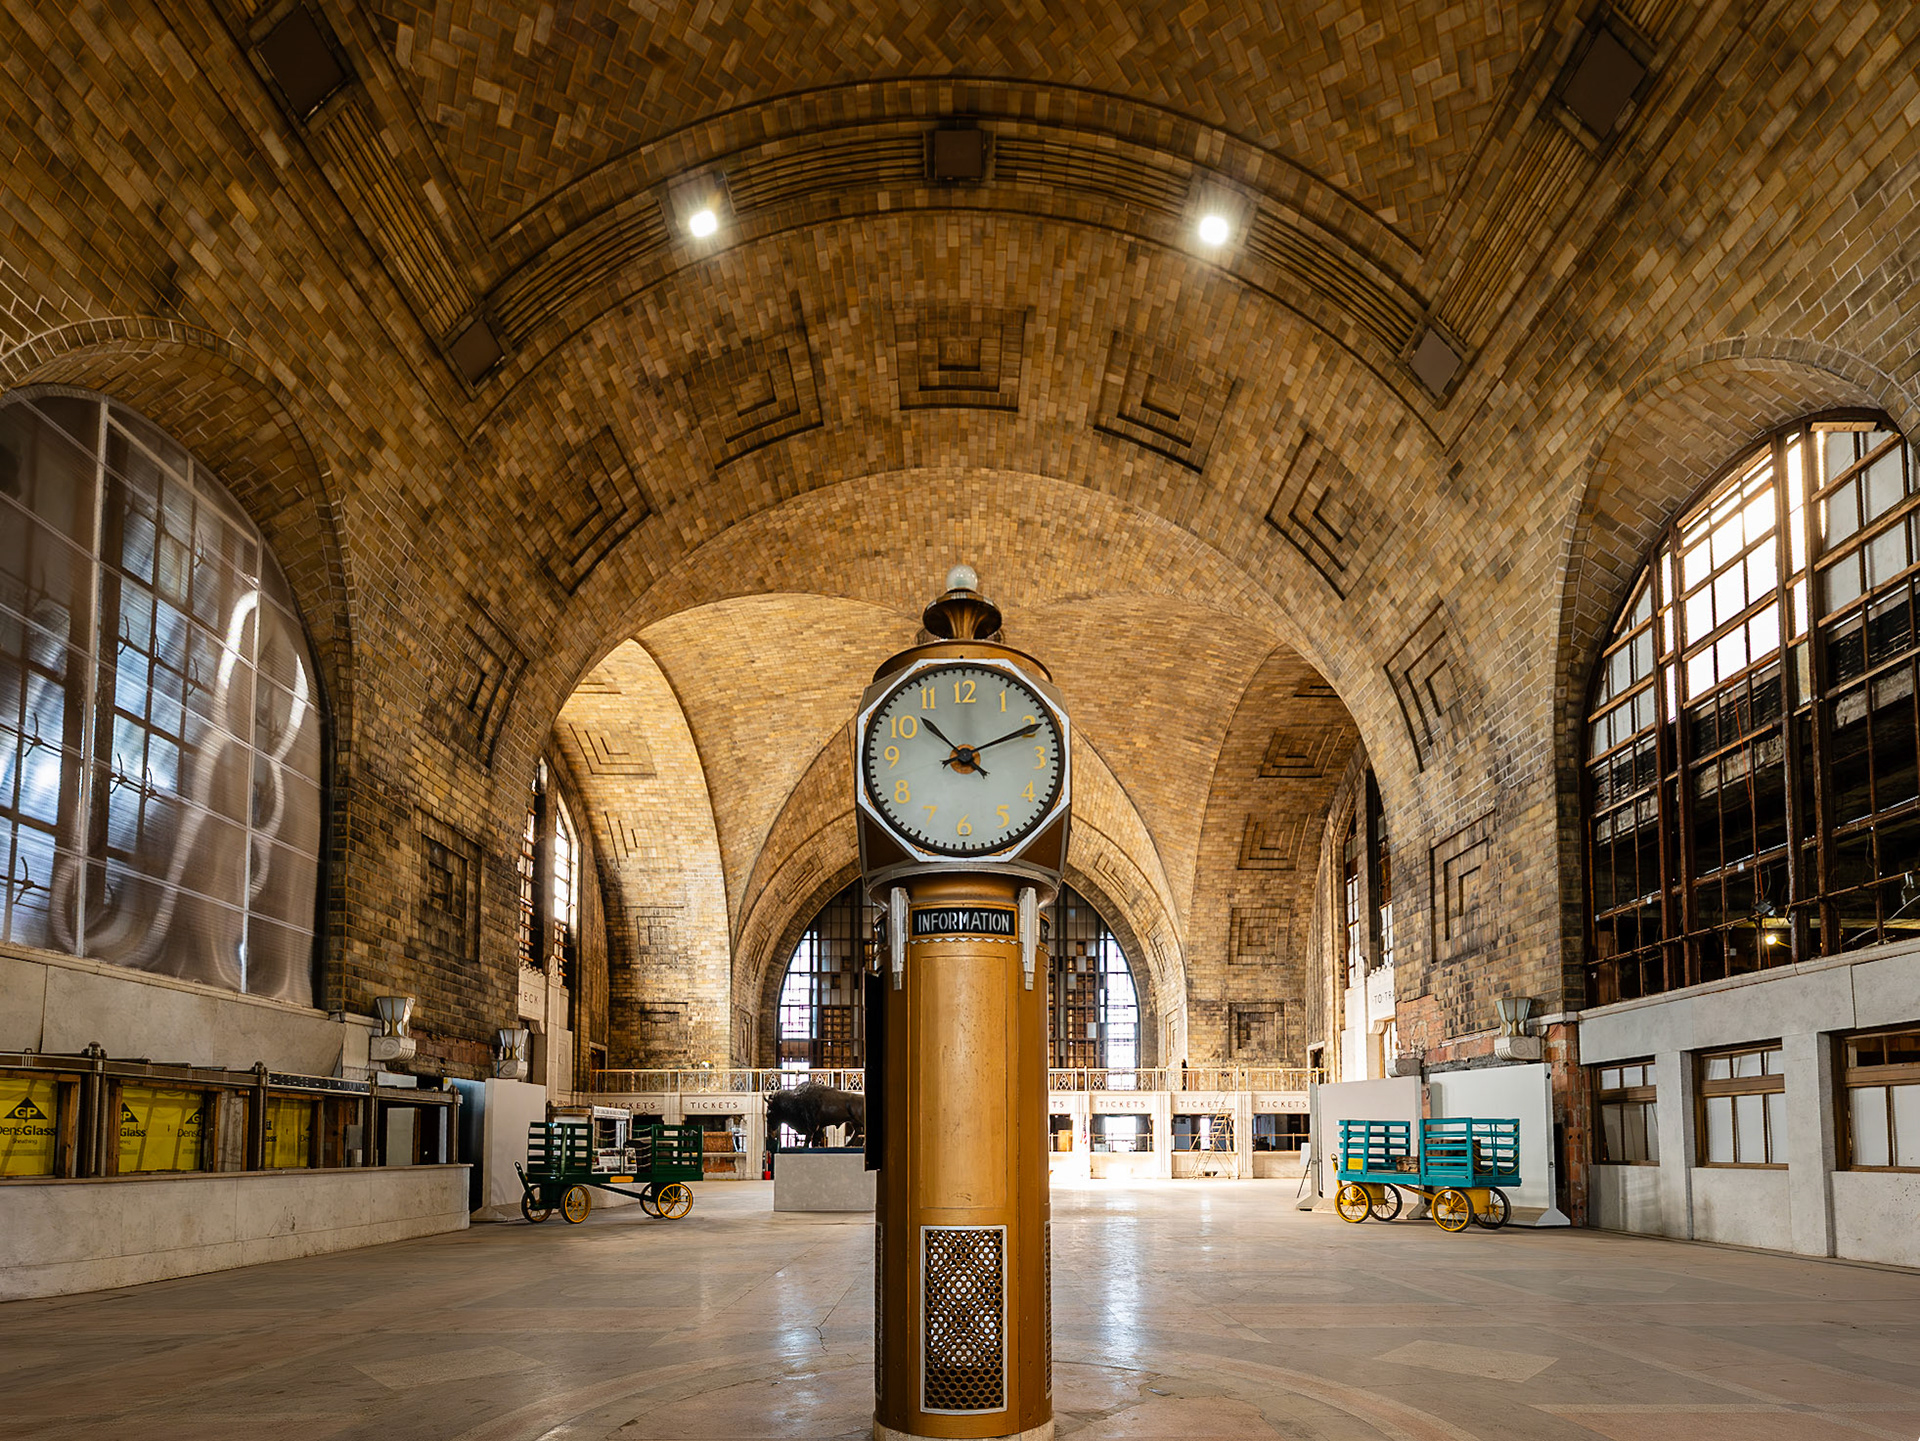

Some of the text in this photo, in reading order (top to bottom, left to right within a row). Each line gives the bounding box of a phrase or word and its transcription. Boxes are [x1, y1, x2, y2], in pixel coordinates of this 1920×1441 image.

[920, 687, 936, 709] 11
[953, 680, 977, 704] 12
[998, 690, 1007, 713] 1
[890, 715, 918, 739] 10
[1021, 715, 1036, 738] 2
[884, 746, 900, 769] 9
[1033, 746, 1047, 770] 3
[894, 780, 911, 804] 8
[1021, 780, 1036, 802] 4
[922, 805, 938, 826] 7
[956, 814, 973, 836] 6
[996, 805, 1010, 828] 5
[918, 911, 1010, 933] INFORMATION
[14, 1106, 38, 1118] GP
[608, 1101, 656, 1109] TICKETS
[690, 1101, 738, 1109] TICKETS
